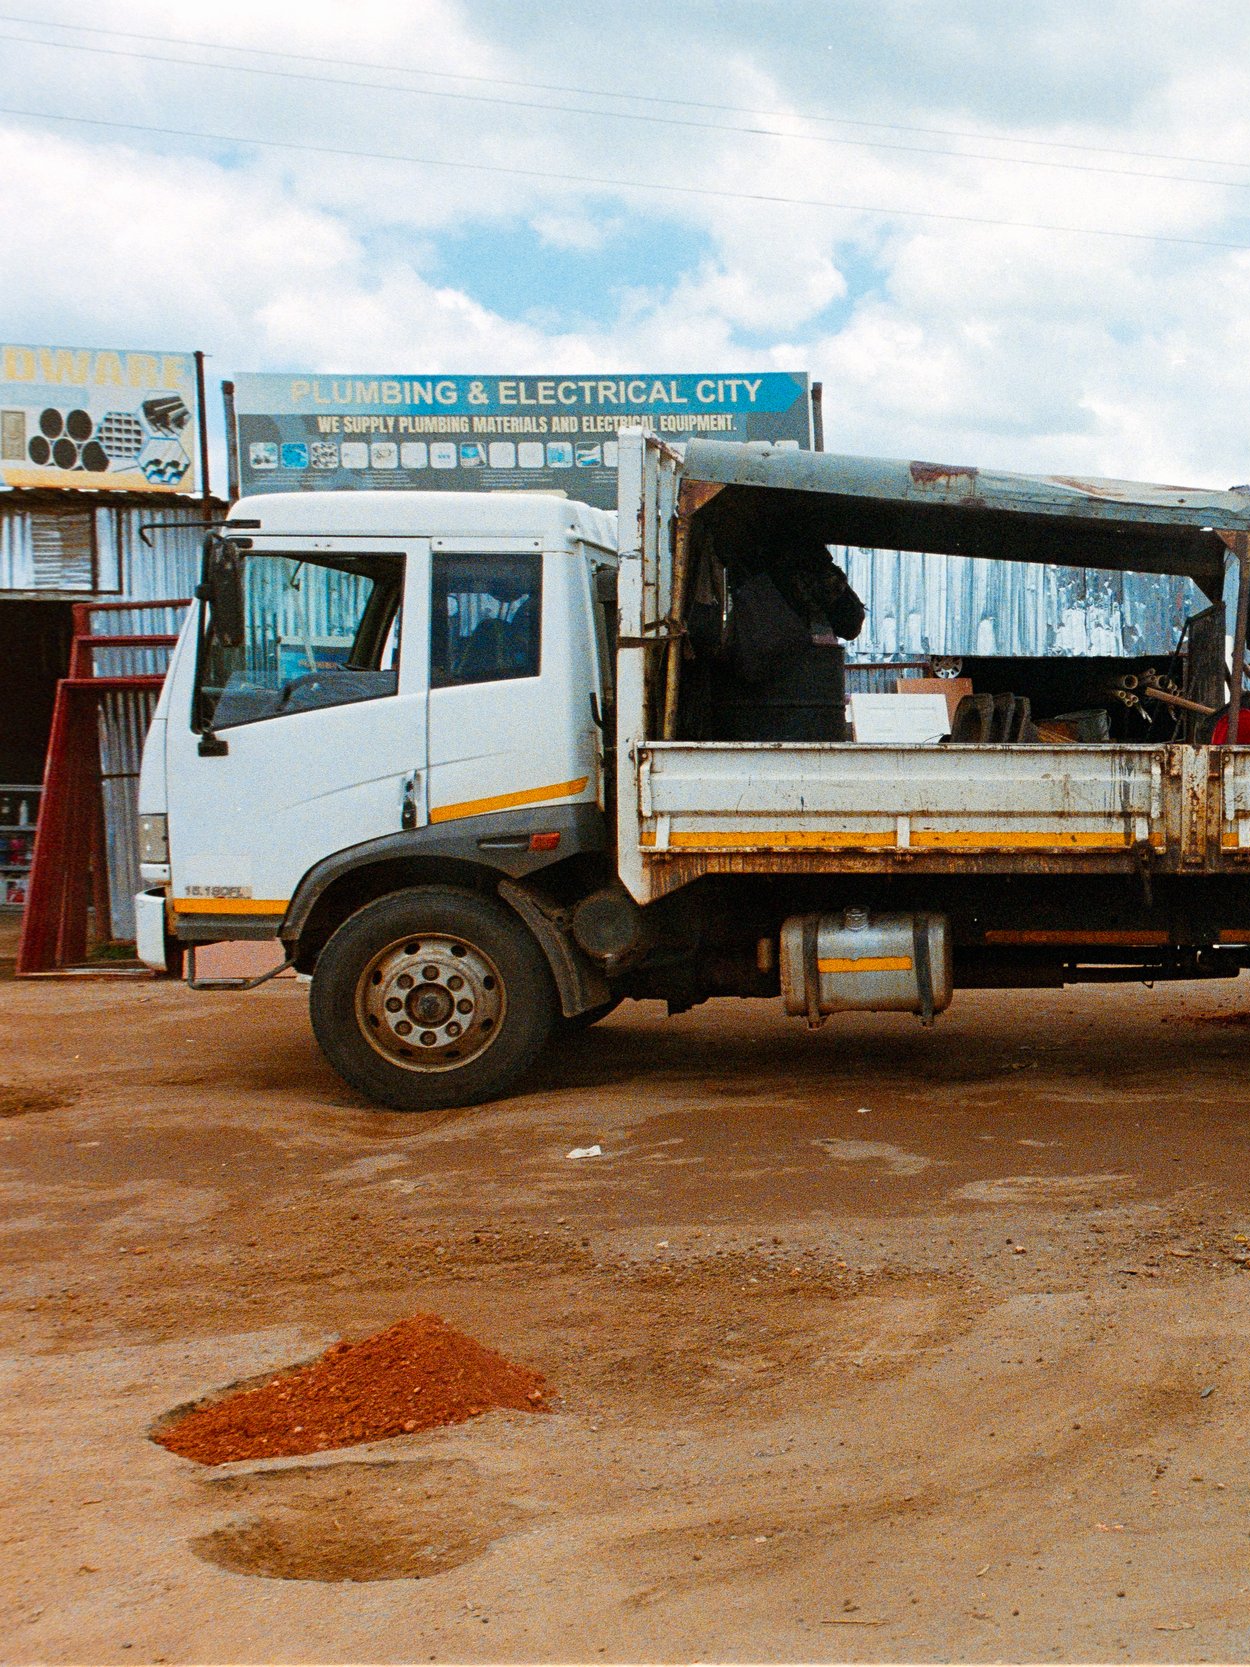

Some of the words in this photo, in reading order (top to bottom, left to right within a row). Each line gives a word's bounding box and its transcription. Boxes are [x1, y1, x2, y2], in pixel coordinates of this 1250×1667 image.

[290, 380, 457, 404] PLUMBING
[467, 380, 489, 404] &
[498, 379, 688, 404] ELECTRICAL
[696, 379, 763, 403] CITY
[317, 416, 341, 433] WE
[343, 416, 396, 433] SUPPLY
[399, 416, 469, 433] PLUMBING
[472, 415, 548, 433] MATERIALS
[551, 415, 579, 433] AND
[660, 413, 738, 432] EQUIPMENT.
